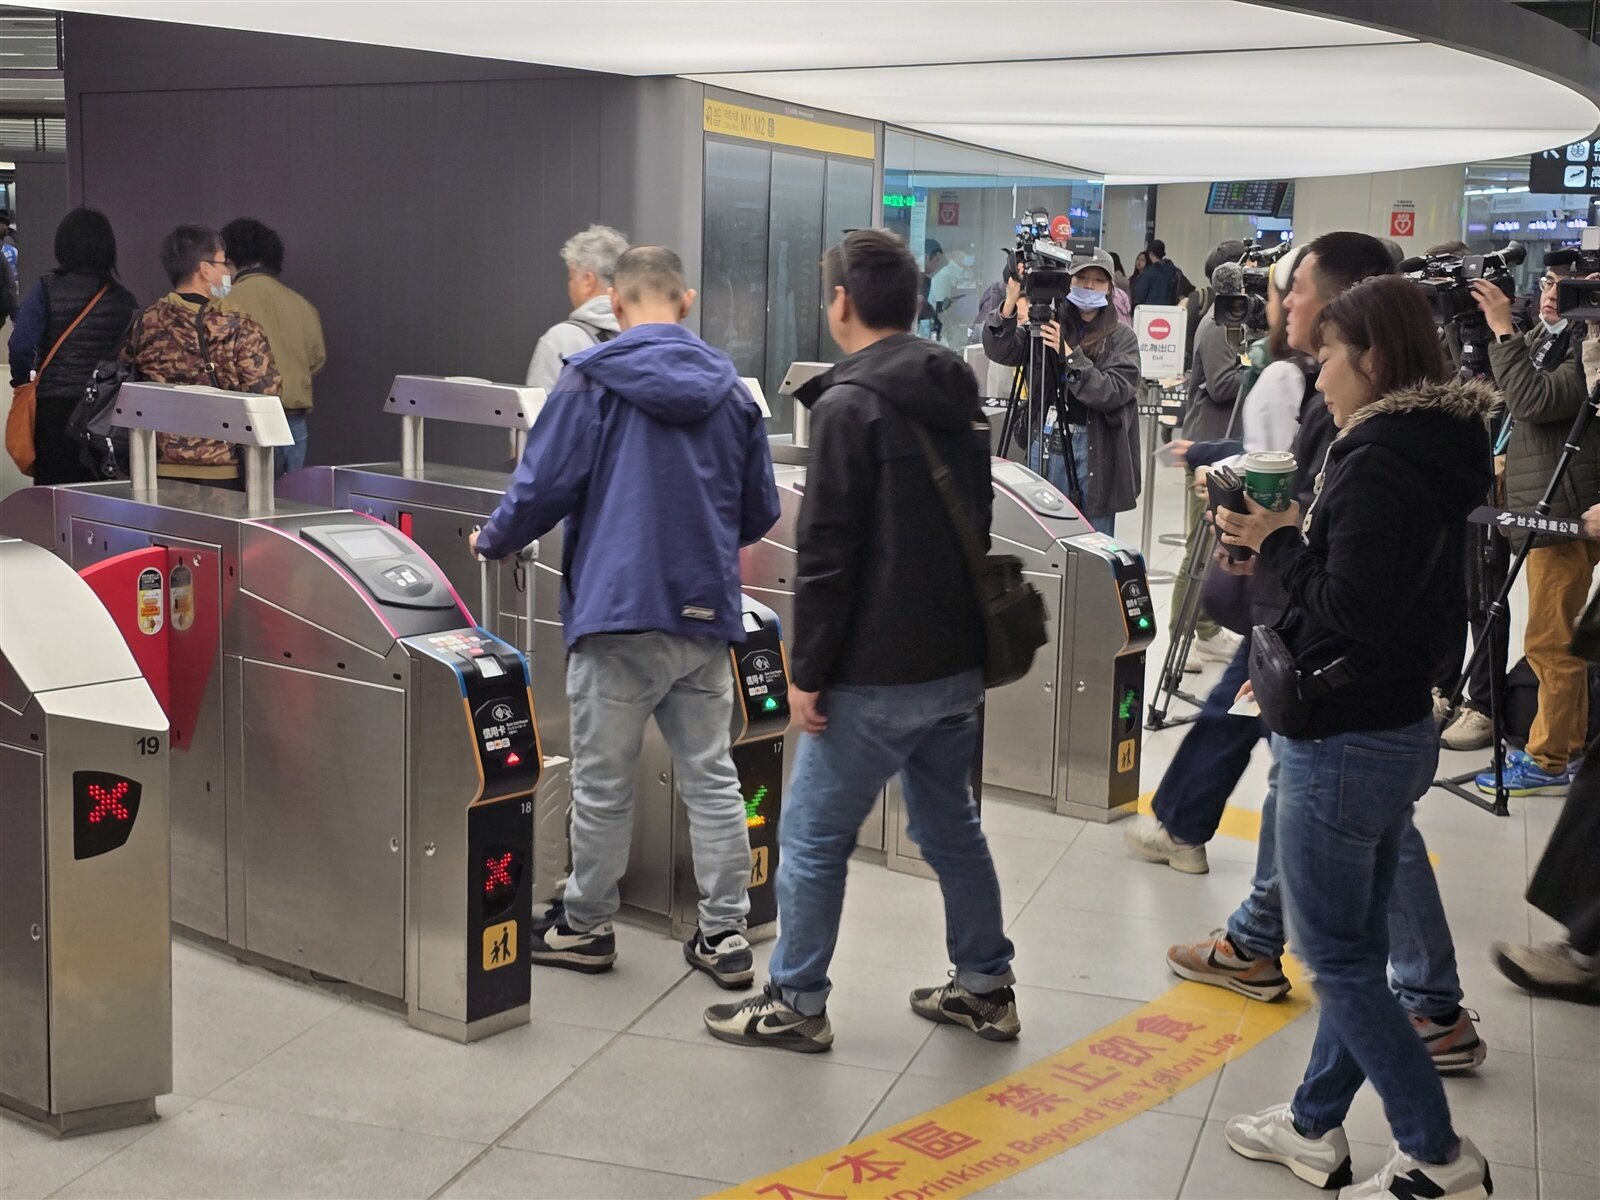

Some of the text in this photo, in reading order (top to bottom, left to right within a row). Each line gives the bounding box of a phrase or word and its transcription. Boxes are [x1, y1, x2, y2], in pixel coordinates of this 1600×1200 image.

[1516, 515, 1579, 534] 台北捷運公司
[482, 724, 506, 740] 信用卡
[136, 736, 160, 756] 19
[773, 742, 783, 753] 17
[521, 801, 532, 814] 18
[985, 1014, 1207, 1118] 禁止飲食
[1006, 1107, 1109, 1155] Beyond
[1097, 1090, 1144, 1112] the
[1129, 1054, 1206, 1091] Yellow
[1194, 1032, 1244, 1057] Line
